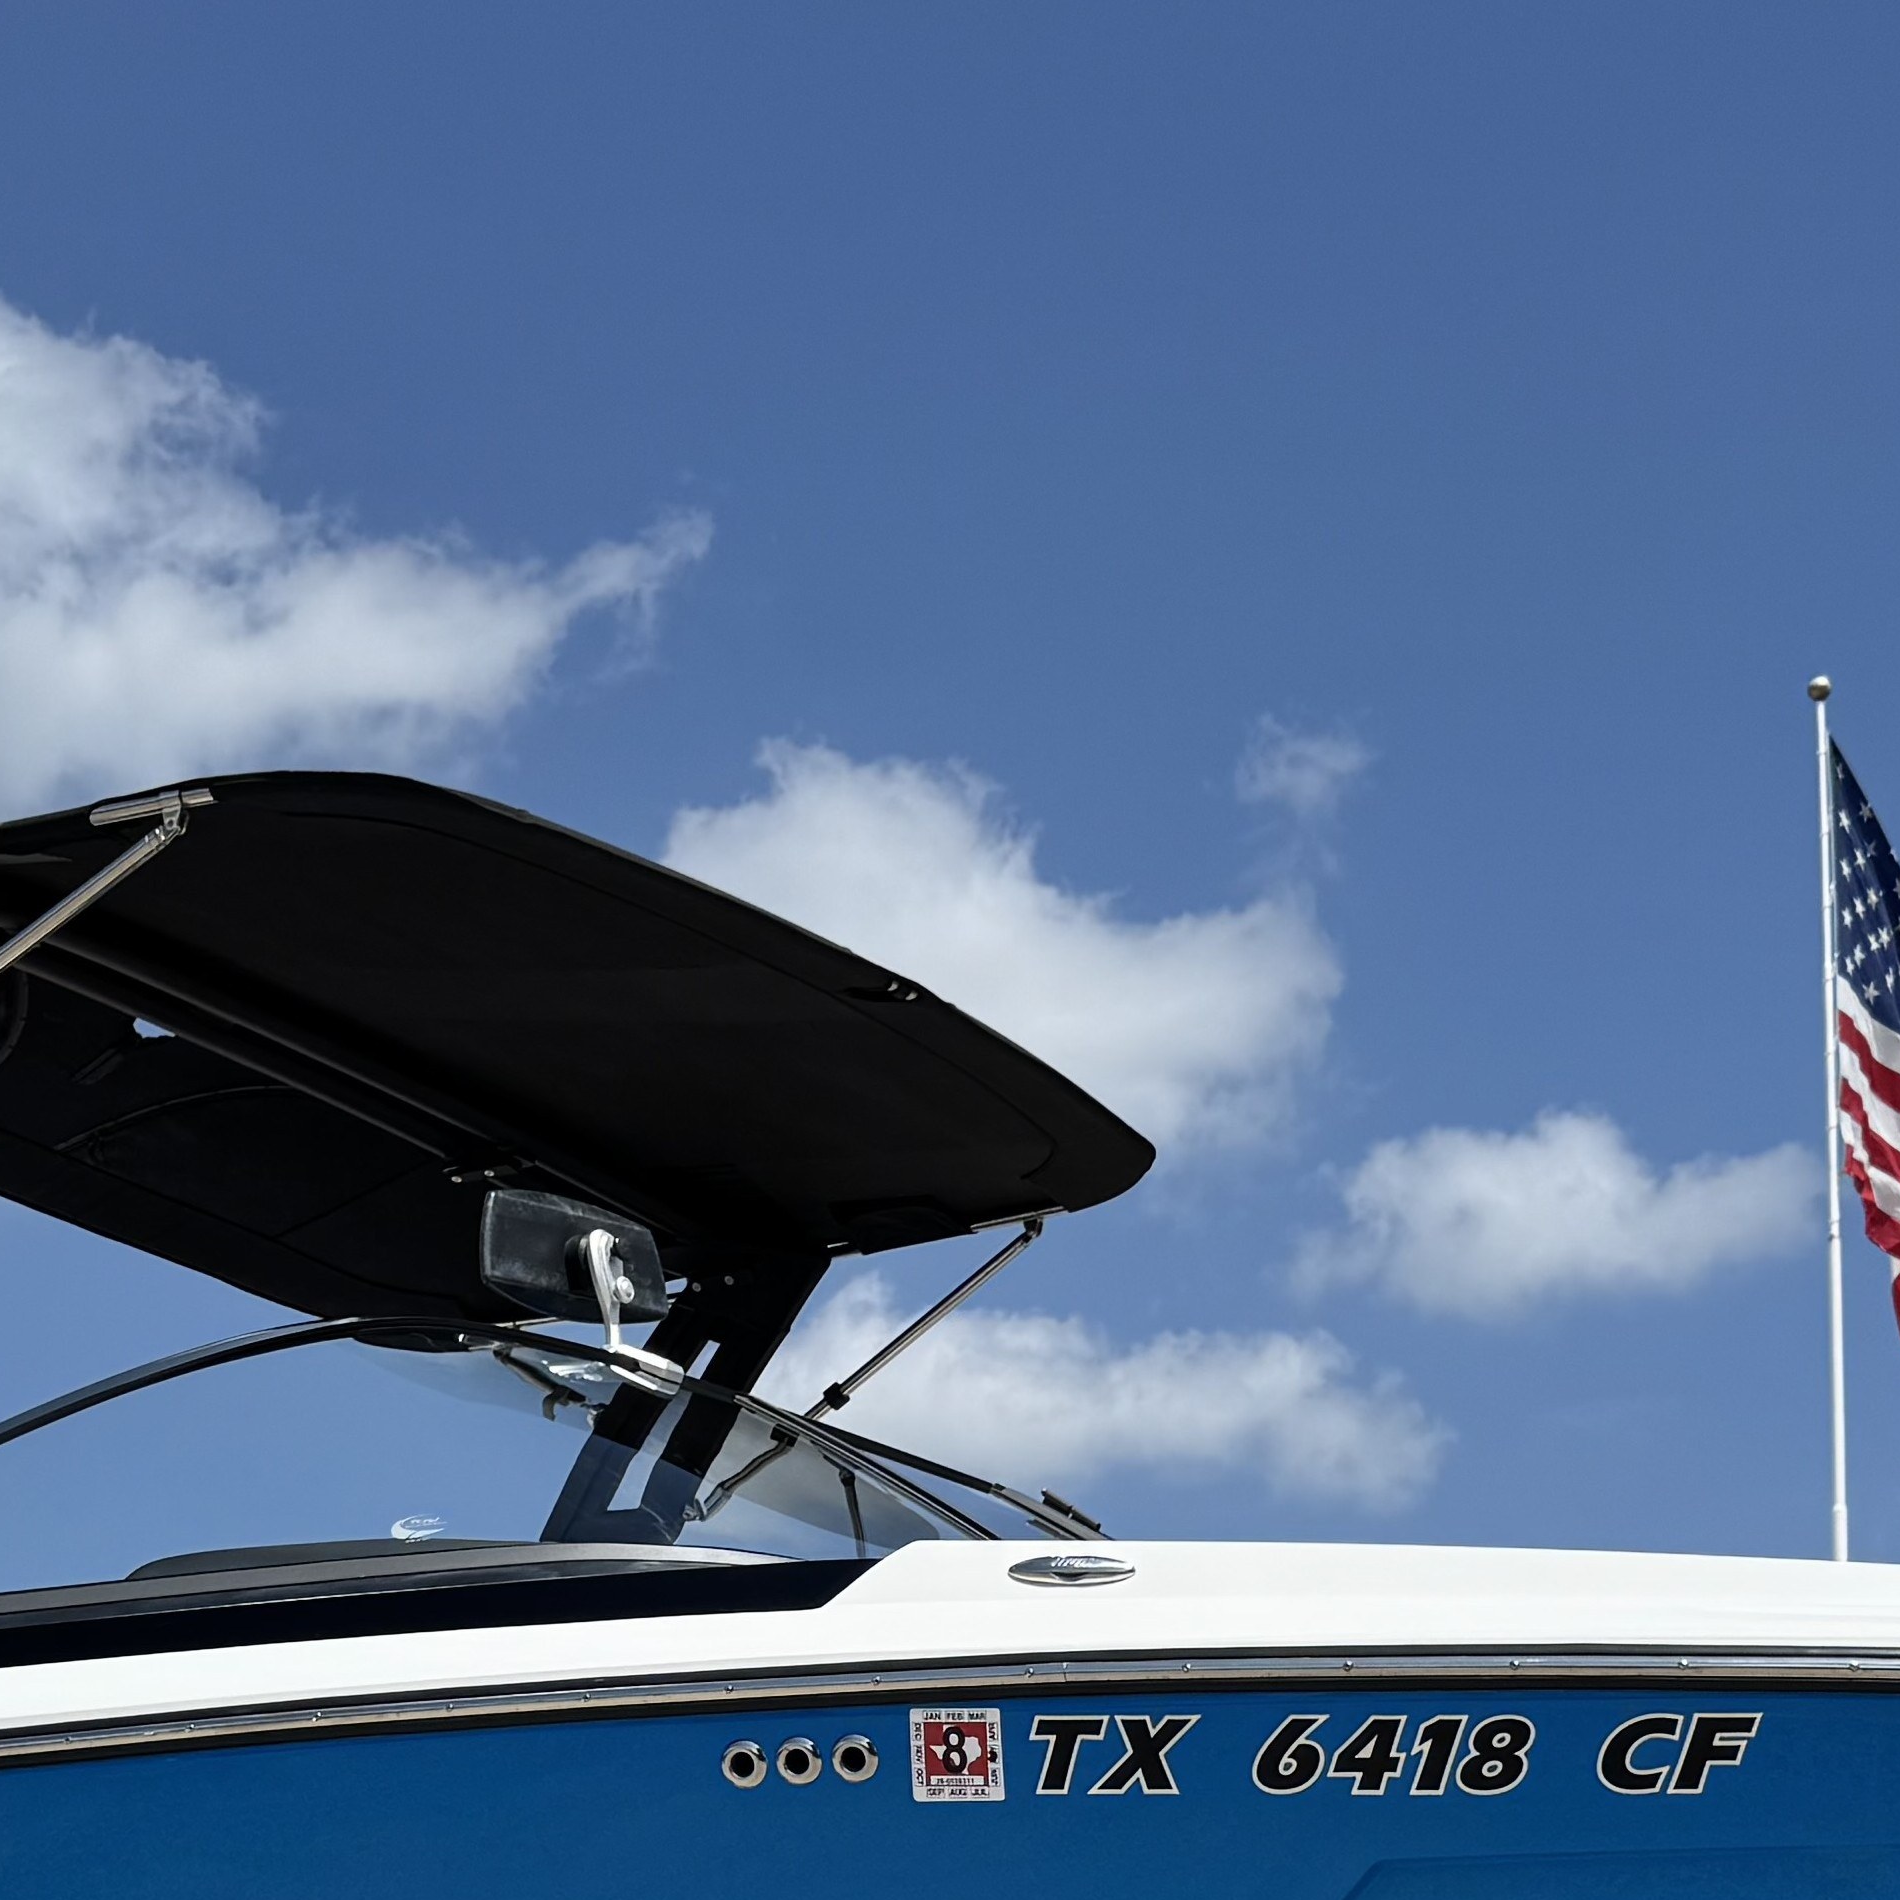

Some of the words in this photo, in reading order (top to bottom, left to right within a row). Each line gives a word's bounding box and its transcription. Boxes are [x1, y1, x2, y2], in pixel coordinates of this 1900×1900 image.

[942, 1726, 968, 1774] 8
[1028, 1713, 1201, 1796] TX
[1251, 1713, 1531, 1797] 6418
[1595, 1712, 1764, 1796] CF
